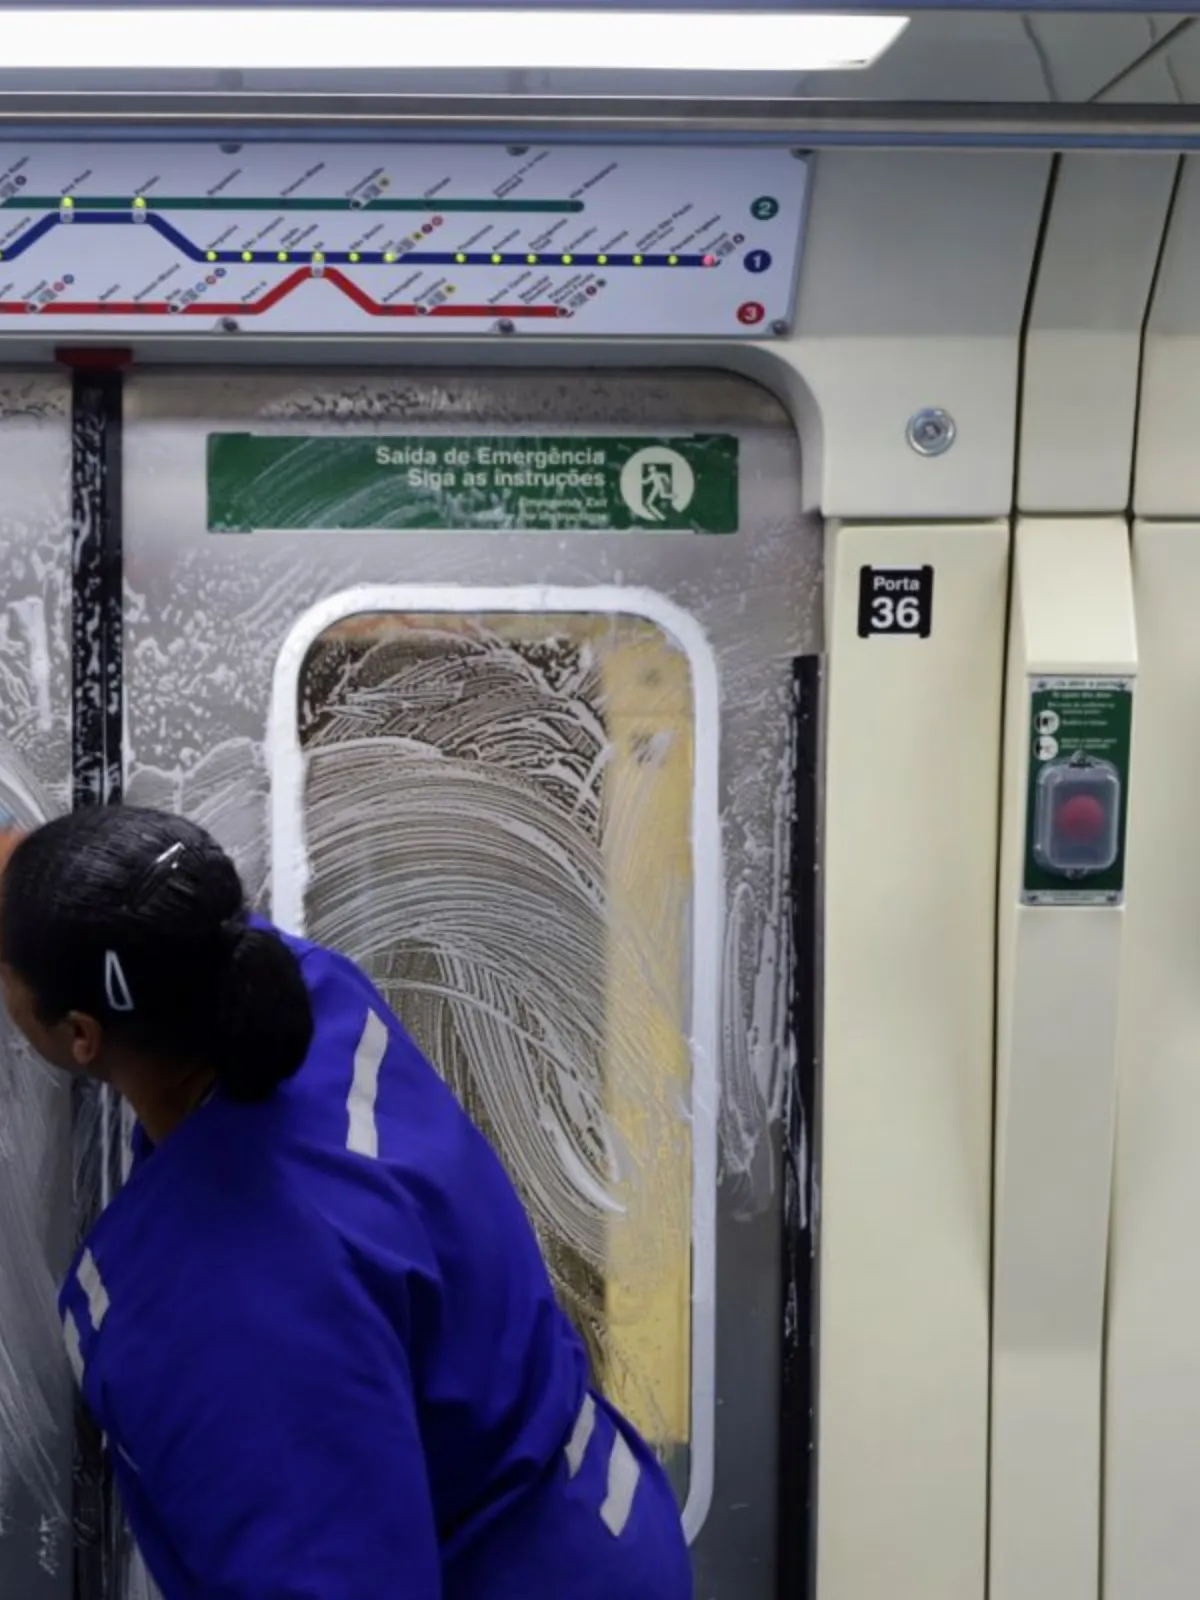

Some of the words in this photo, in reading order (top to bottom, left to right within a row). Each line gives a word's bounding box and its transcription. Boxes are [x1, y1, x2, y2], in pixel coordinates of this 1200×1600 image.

[757, 201, 772, 216] 2
[744, 307, 757, 321] 3
[375, 446, 438, 465] Saída
[443, 447, 470, 465] de
[477, 446, 606, 469] Emergência
[407, 468, 456, 489] Siga
[462, 472, 488, 487] as
[494, 468, 606, 491] instruções
[873, 576, 921, 591] Porta
[870, 595, 920, 630] 36
